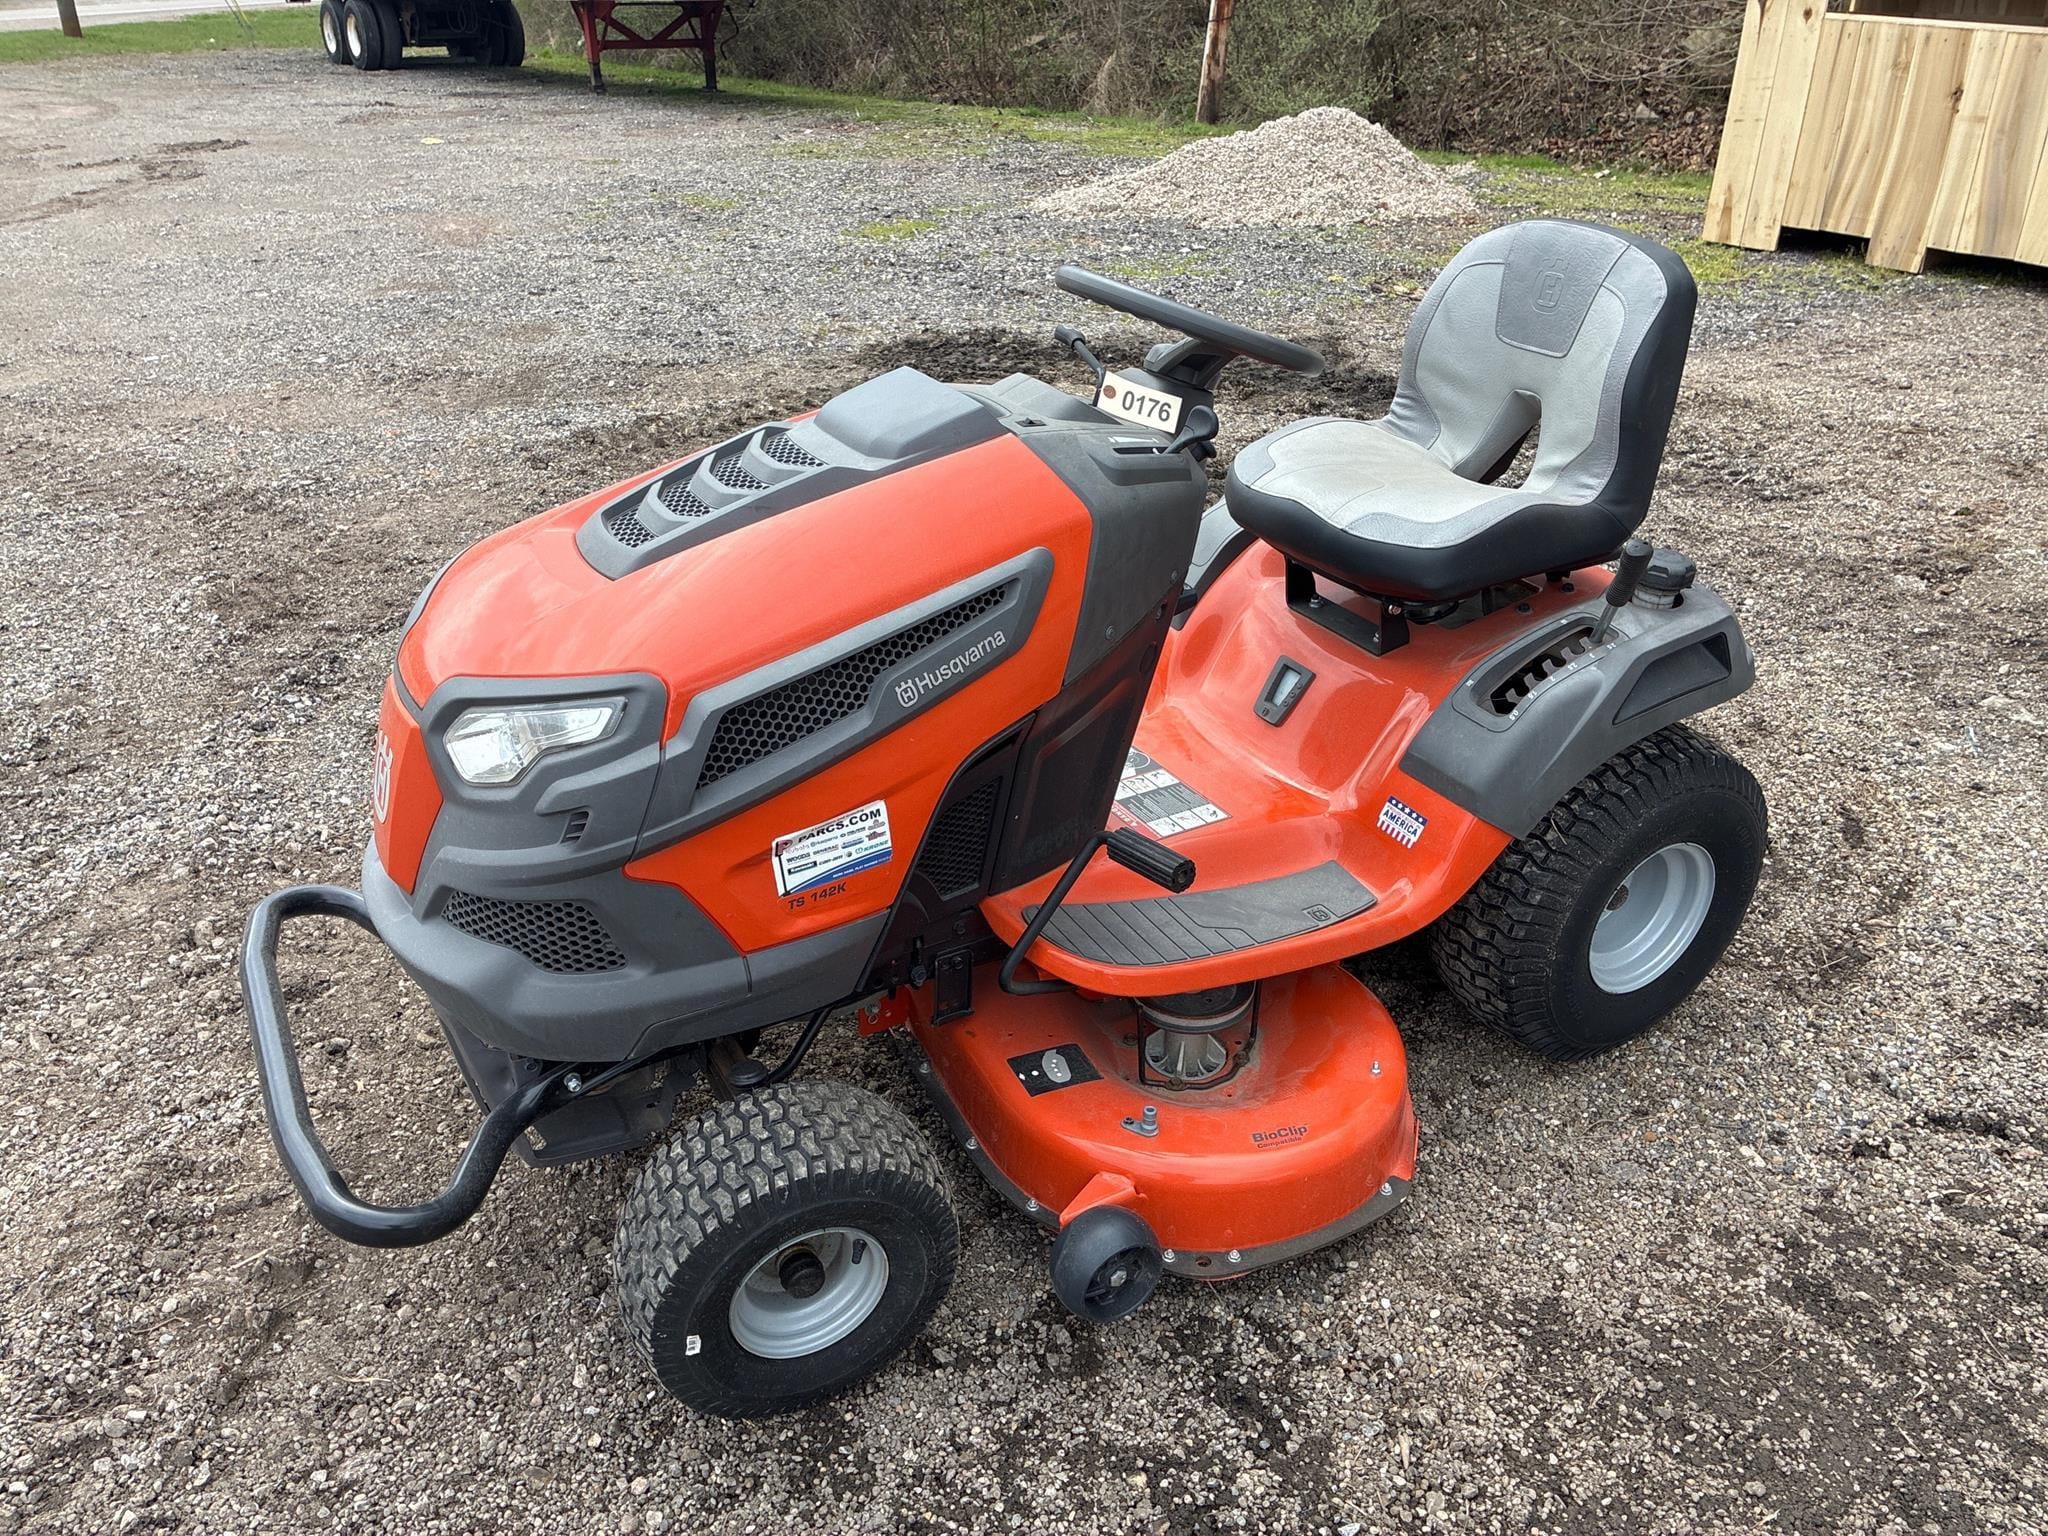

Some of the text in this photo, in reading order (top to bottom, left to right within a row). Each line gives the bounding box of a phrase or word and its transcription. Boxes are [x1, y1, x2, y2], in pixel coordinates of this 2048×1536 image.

[1121, 390, 1172, 422] 0176
[914, 630, 1006, 695] Husqvarna
[1508, 709, 1519, 721] 0.5
[798, 808, 881, 842] PARCS.COM
[1383, 809, 1418, 838] AMERICA
[788, 882, 847, 909] TS 142K
[1252, 1126, 1307, 1143] BioClip
